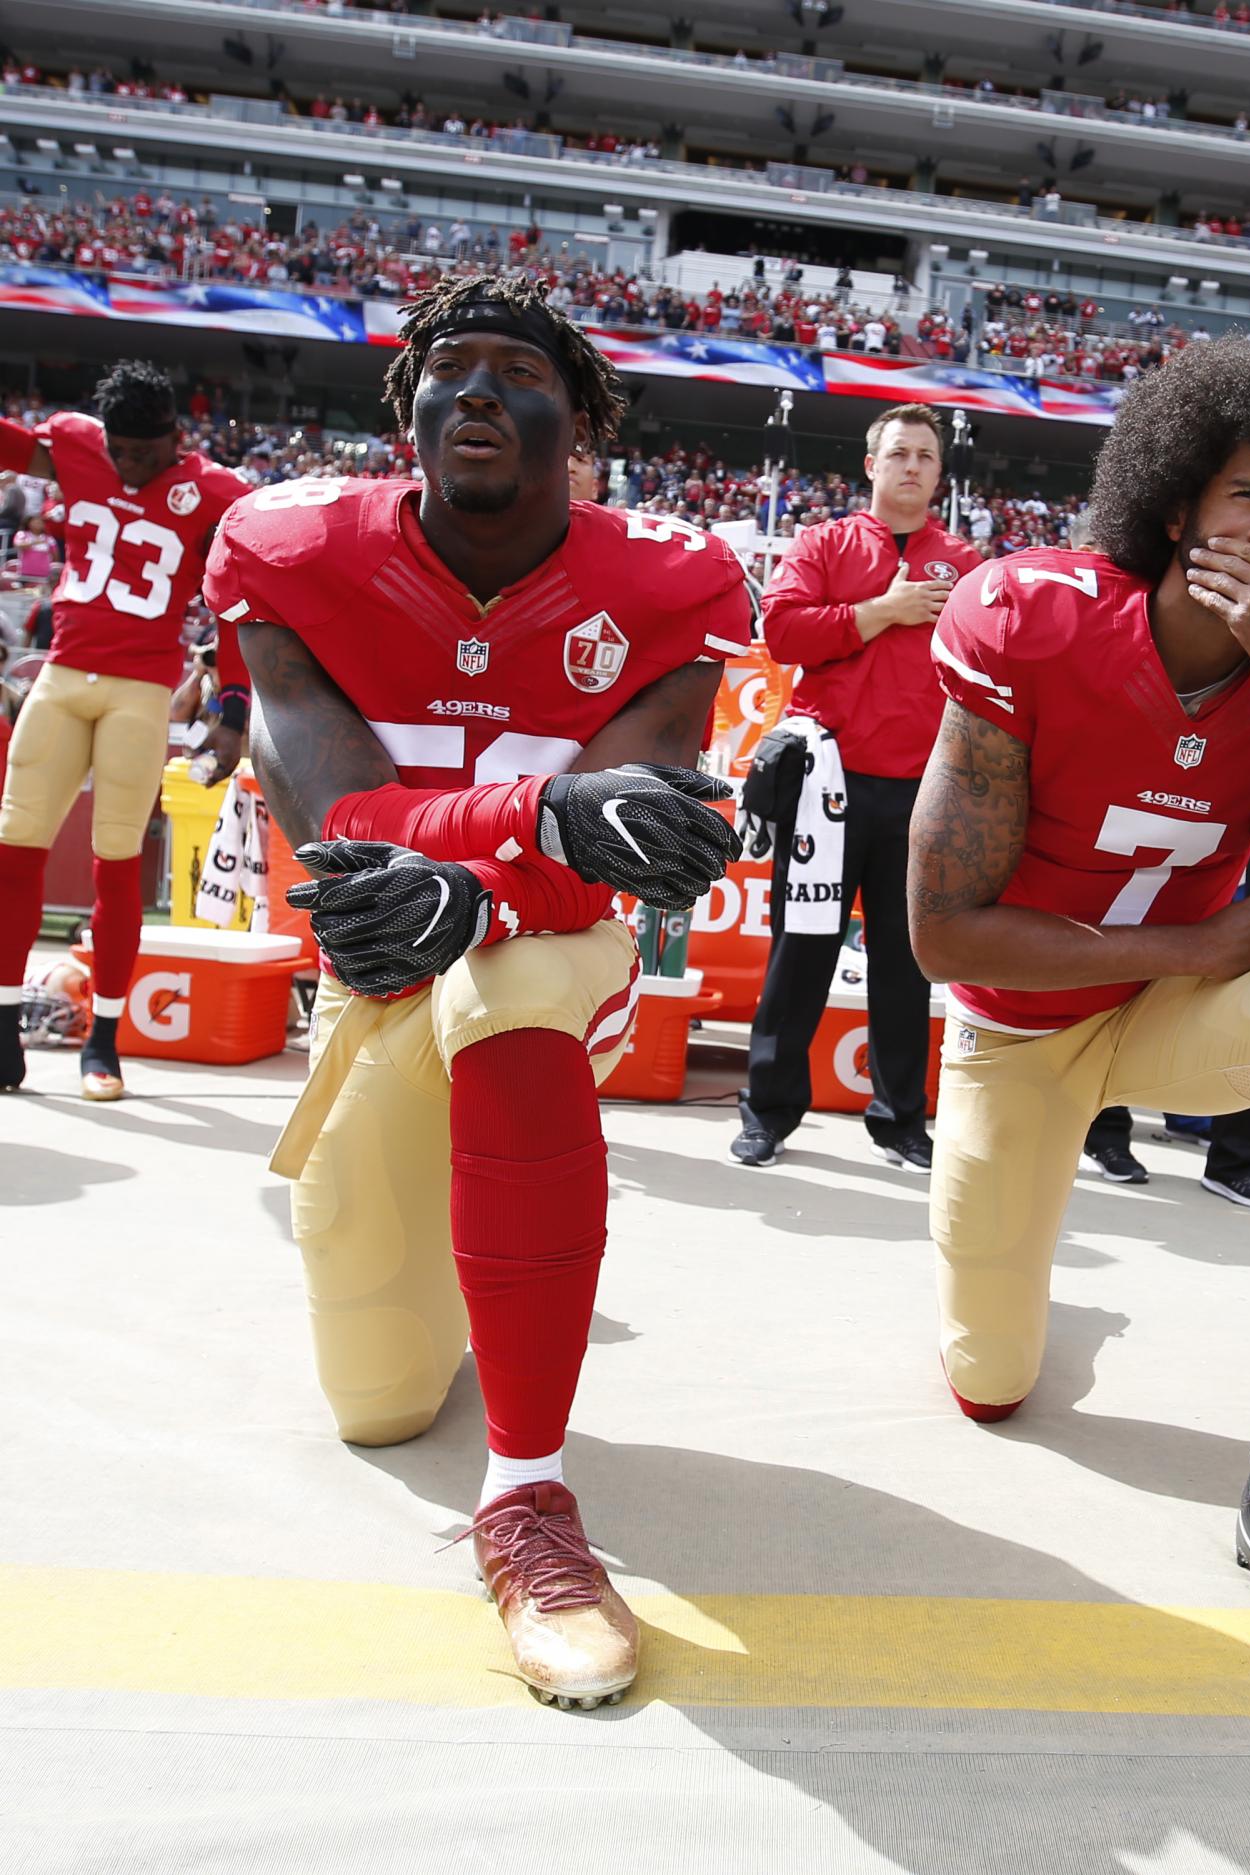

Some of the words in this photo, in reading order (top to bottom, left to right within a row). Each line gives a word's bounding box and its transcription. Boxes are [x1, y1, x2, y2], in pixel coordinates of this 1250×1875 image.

[63, 500, 185, 620] 33
[1018, 567, 1098, 599] 7
[461, 654, 483, 669] NFL
[577, 641, 615, 669] 70
[426, 700, 511, 721] 49ERS
[1179, 748, 1200, 762] NFL
[1136, 790, 1212, 814] 49ERS
[213, 849, 237, 873] G
[1093, 804, 1228, 926] 7
[667, 917, 685, 937] G
[129, 971, 192, 1042] G
